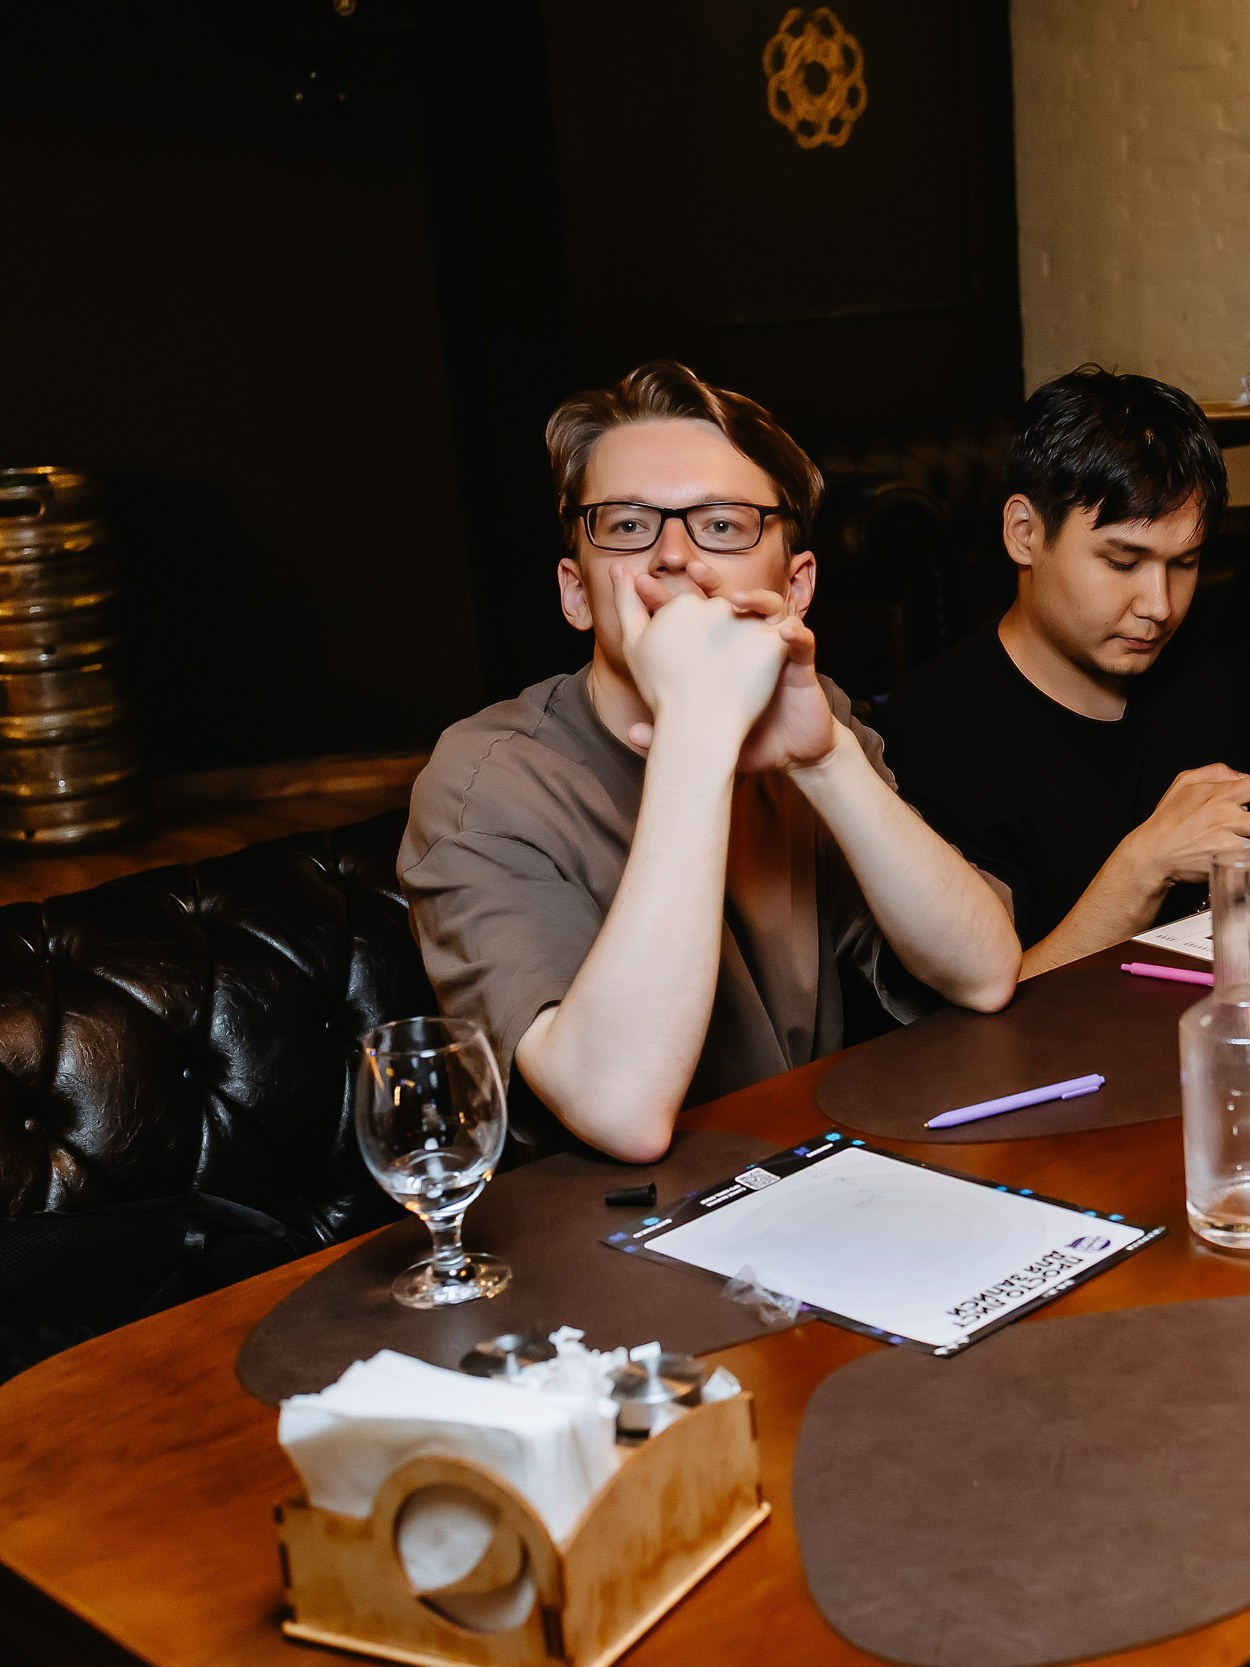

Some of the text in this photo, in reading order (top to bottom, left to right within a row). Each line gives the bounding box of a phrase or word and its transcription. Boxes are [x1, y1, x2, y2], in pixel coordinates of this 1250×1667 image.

[1006, 1256, 1083, 1298] ПРОСТО
[1024, 1250, 1065, 1273] ДЛЯ
[946, 1274, 1029, 1316] ЗАПИСИ
[952, 1299, 1005, 1327] ЛИСТ
